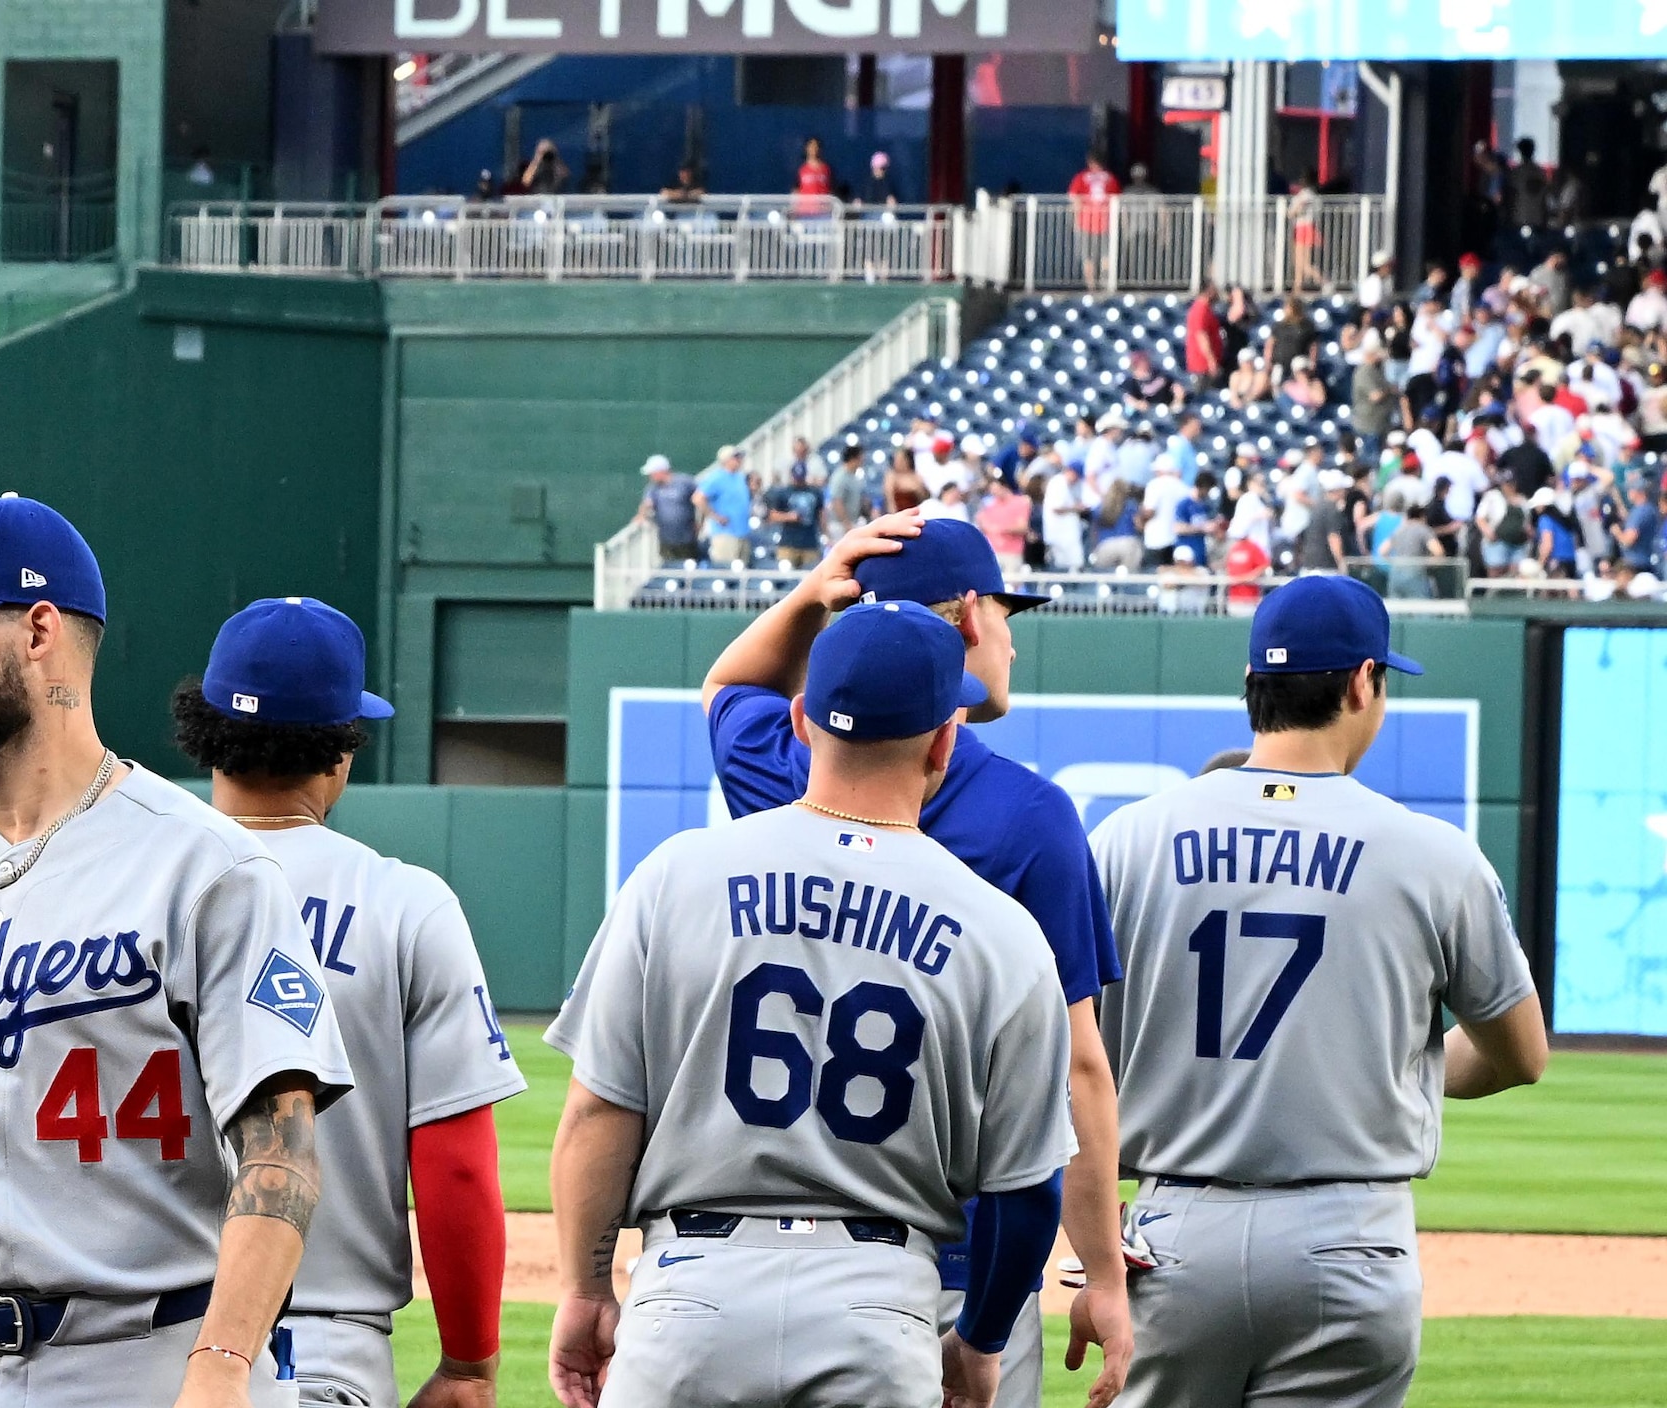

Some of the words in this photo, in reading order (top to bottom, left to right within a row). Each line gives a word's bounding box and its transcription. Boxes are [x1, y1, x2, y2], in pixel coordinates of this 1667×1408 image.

[1173, 827, 1366, 896] OHTANI
[727, 871, 963, 977] RUSHING
[1188, 909, 1327, 1061] 17
[35, 1047, 192, 1162] 44
[724, 961, 926, 1146] 68
